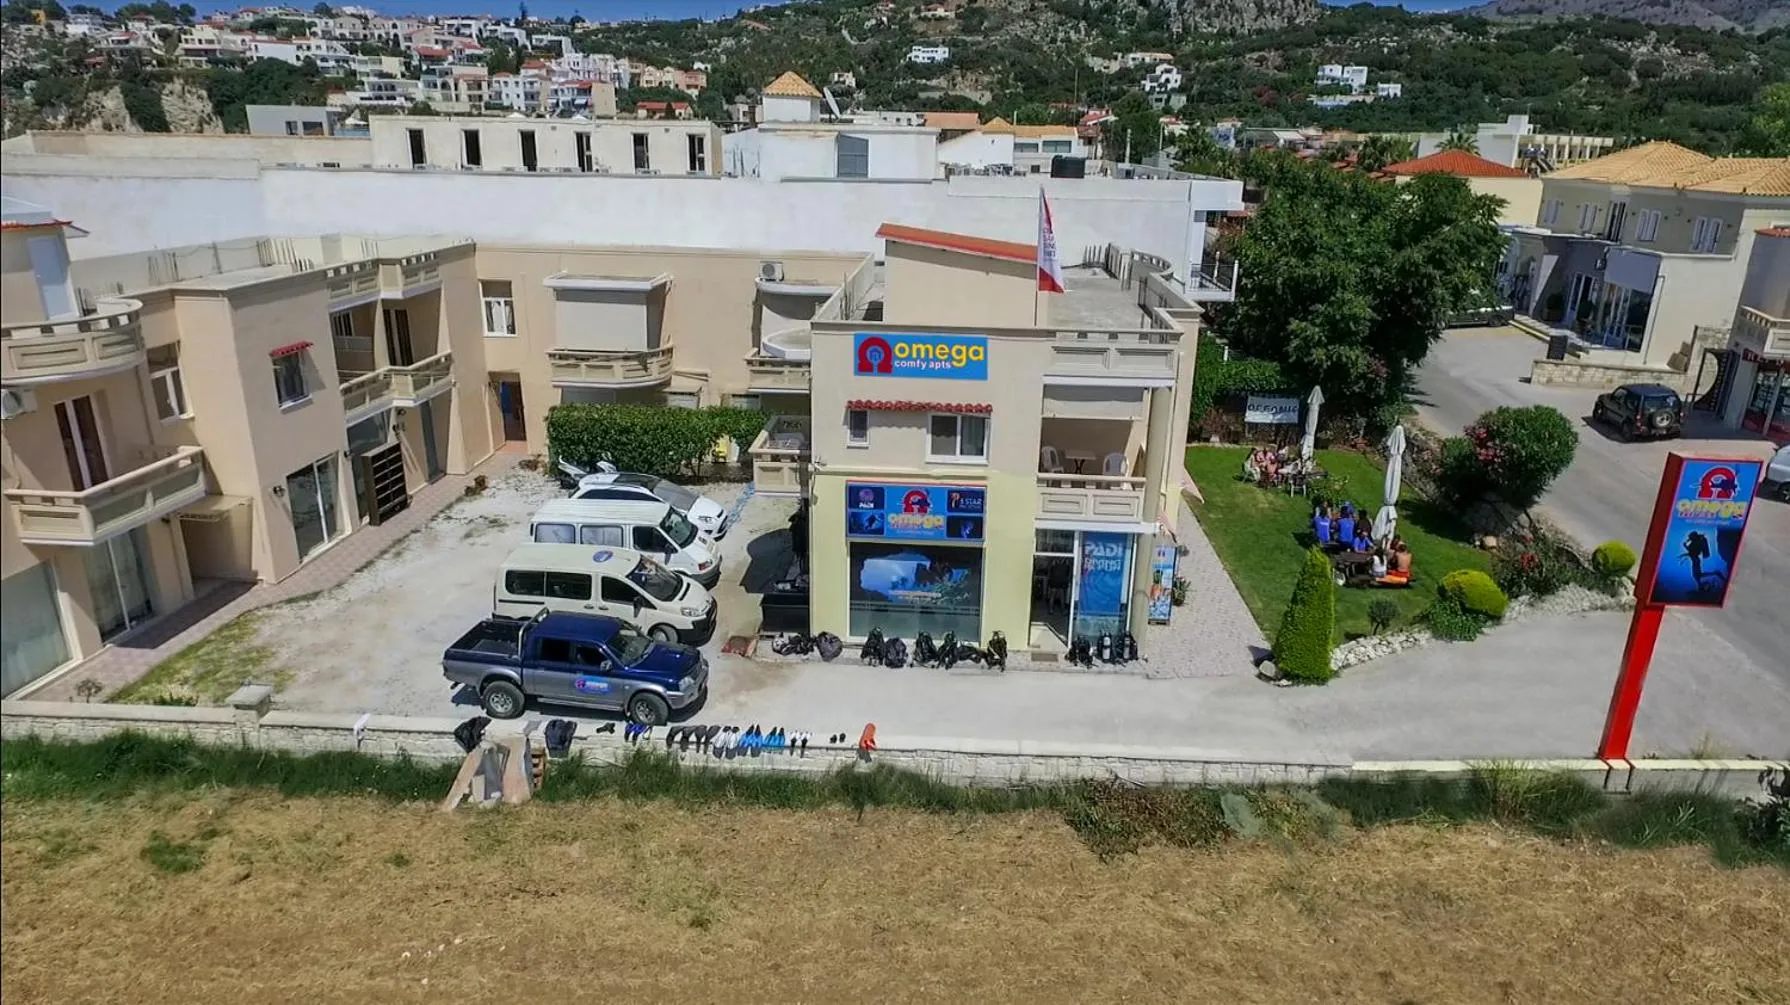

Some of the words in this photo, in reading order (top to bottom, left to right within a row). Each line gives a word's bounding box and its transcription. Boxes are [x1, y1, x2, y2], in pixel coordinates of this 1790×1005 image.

[894, 342, 985, 367] omega
[894, 359, 927, 370] comfy
[929, 360, 952, 370] apts
[1084, 541, 1124, 557] PADI
